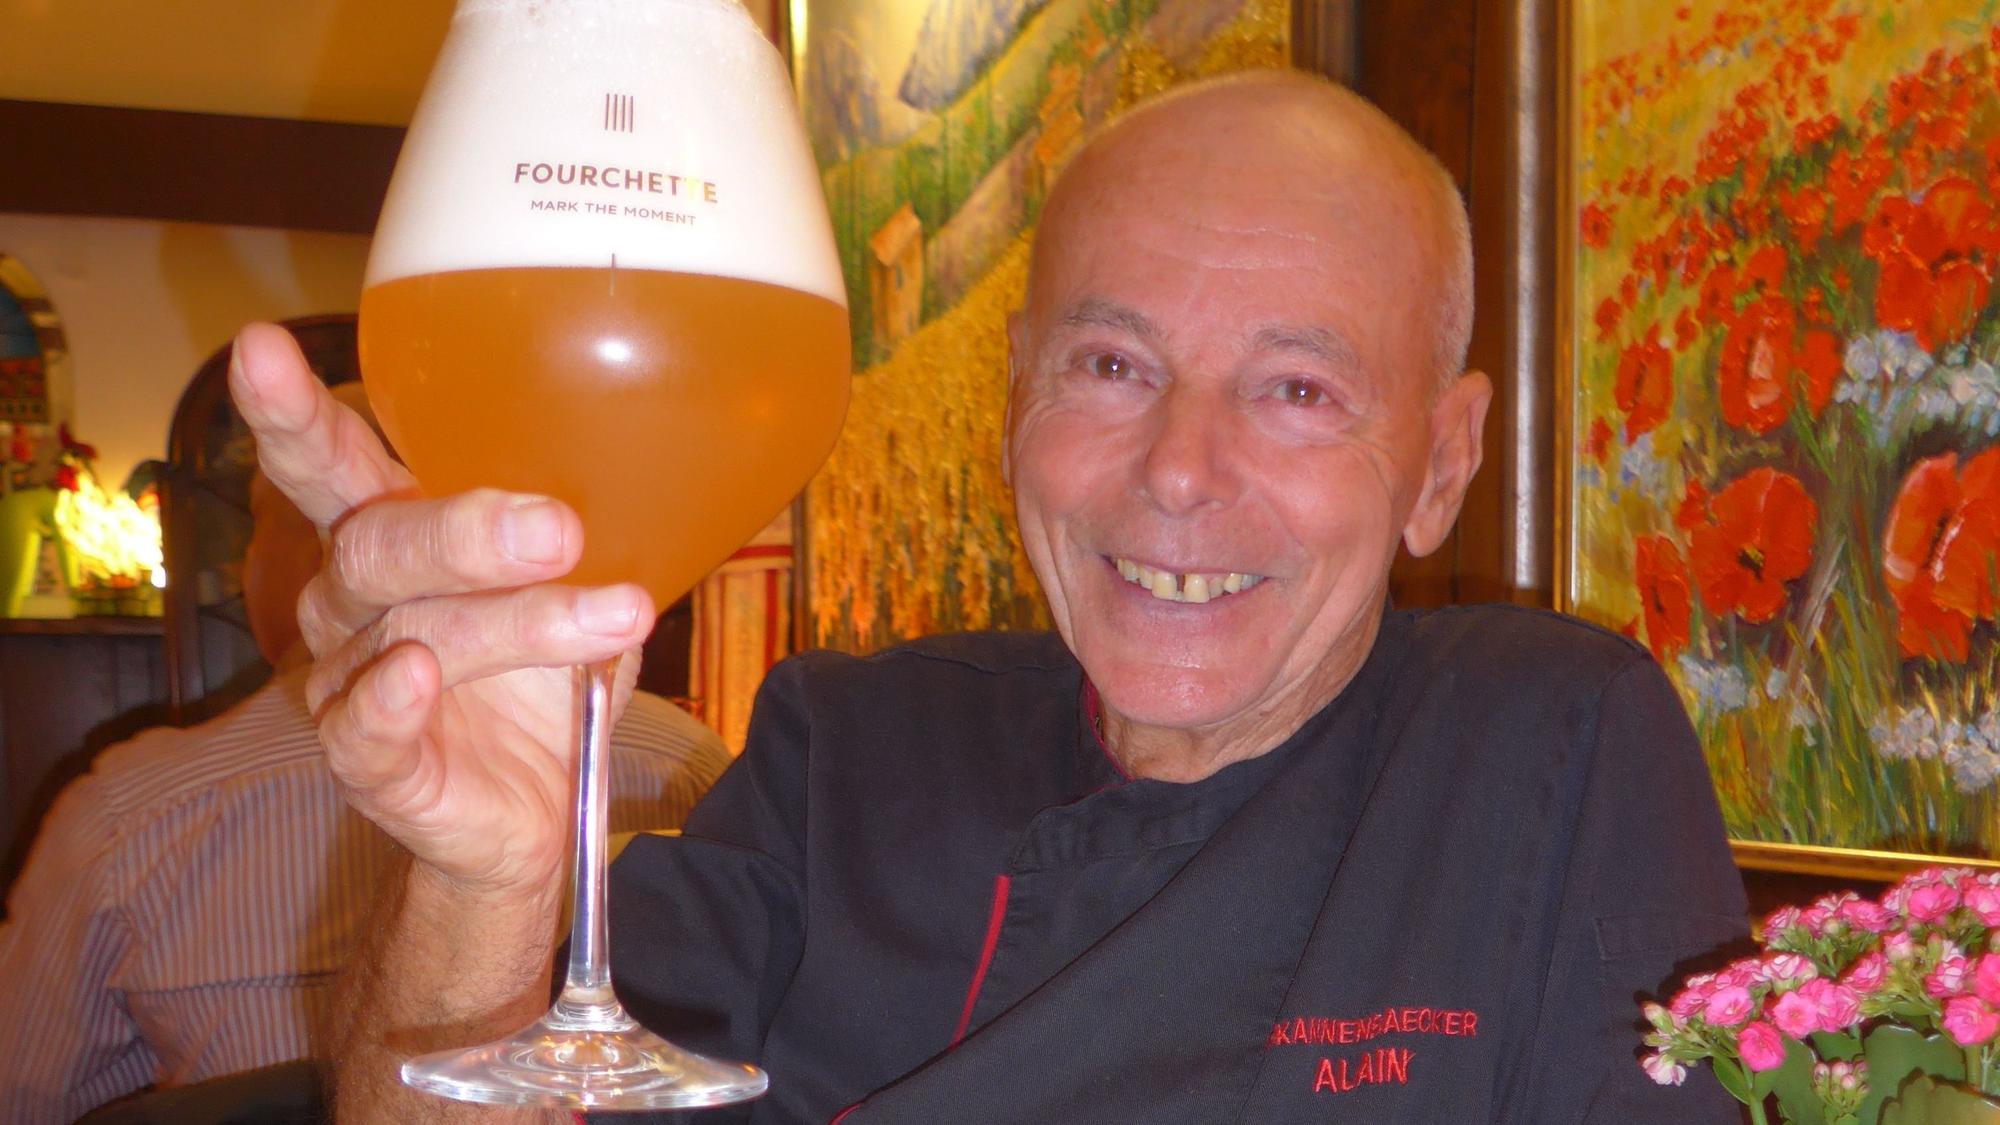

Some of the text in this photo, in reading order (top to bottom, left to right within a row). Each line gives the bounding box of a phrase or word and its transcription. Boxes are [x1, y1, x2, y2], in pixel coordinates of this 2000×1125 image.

[513, 162, 719, 204] FOURCHETTE
[530, 199, 697, 226] MARK THE MOMENT
[1312, 1047, 1416, 1094] ALAIN
